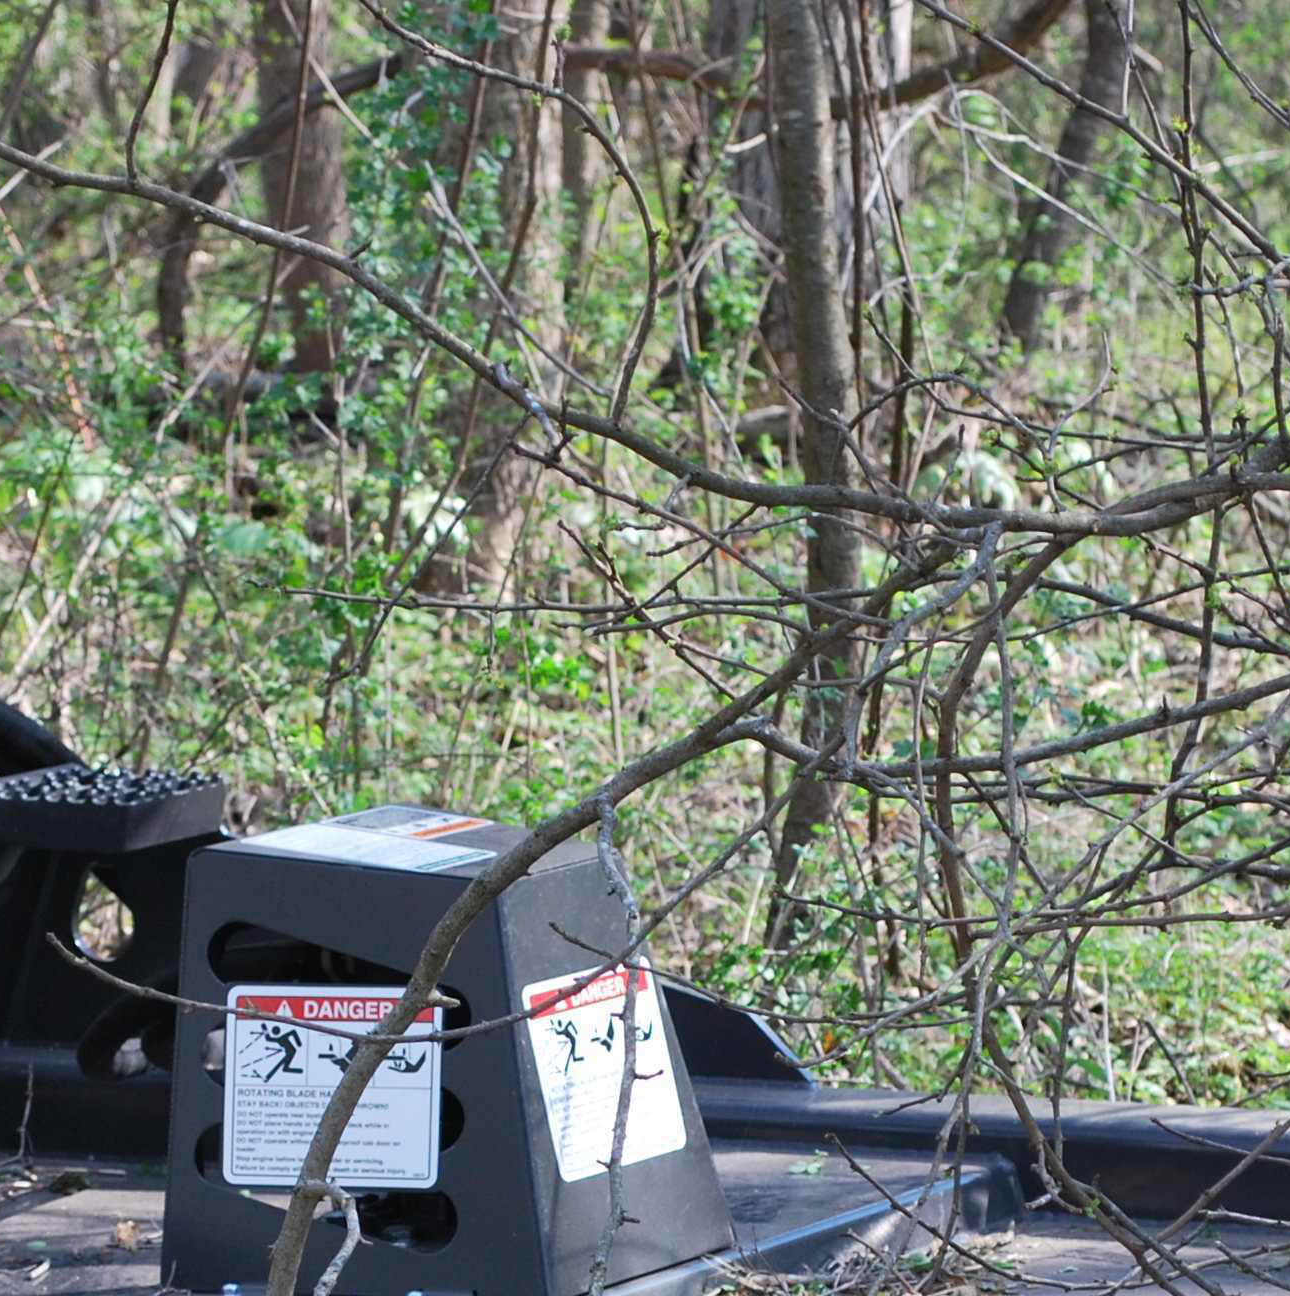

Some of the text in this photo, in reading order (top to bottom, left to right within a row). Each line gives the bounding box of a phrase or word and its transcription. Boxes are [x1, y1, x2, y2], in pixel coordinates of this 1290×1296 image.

[302, 999, 396, 1020] DANGER
[236, 1088, 284, 1098] ROTATING
[286, 1089, 317, 1098] BLADE
